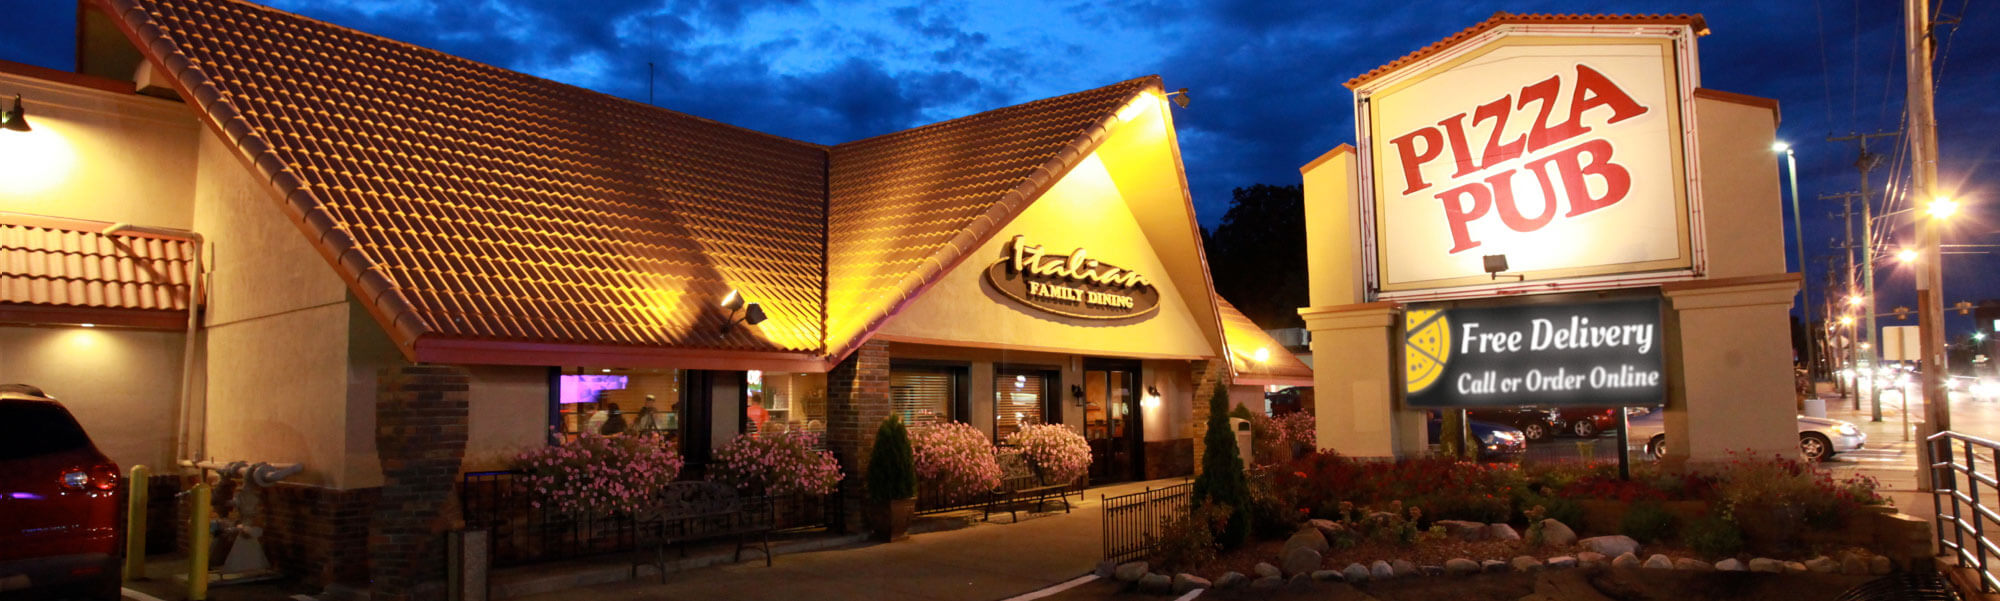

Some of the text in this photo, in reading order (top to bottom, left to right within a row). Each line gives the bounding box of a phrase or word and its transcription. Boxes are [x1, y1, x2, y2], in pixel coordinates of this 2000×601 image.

[1390, 64, 1648, 195] PIZZA
[1434, 139, 1631, 254] PUB
[1012, 235, 1151, 288] Italian
[1030, 281, 1134, 309] FAMILY DINING
[1461, 315, 1653, 354] Free Delivery
[1457, 364, 1660, 394] Call or Order Online
